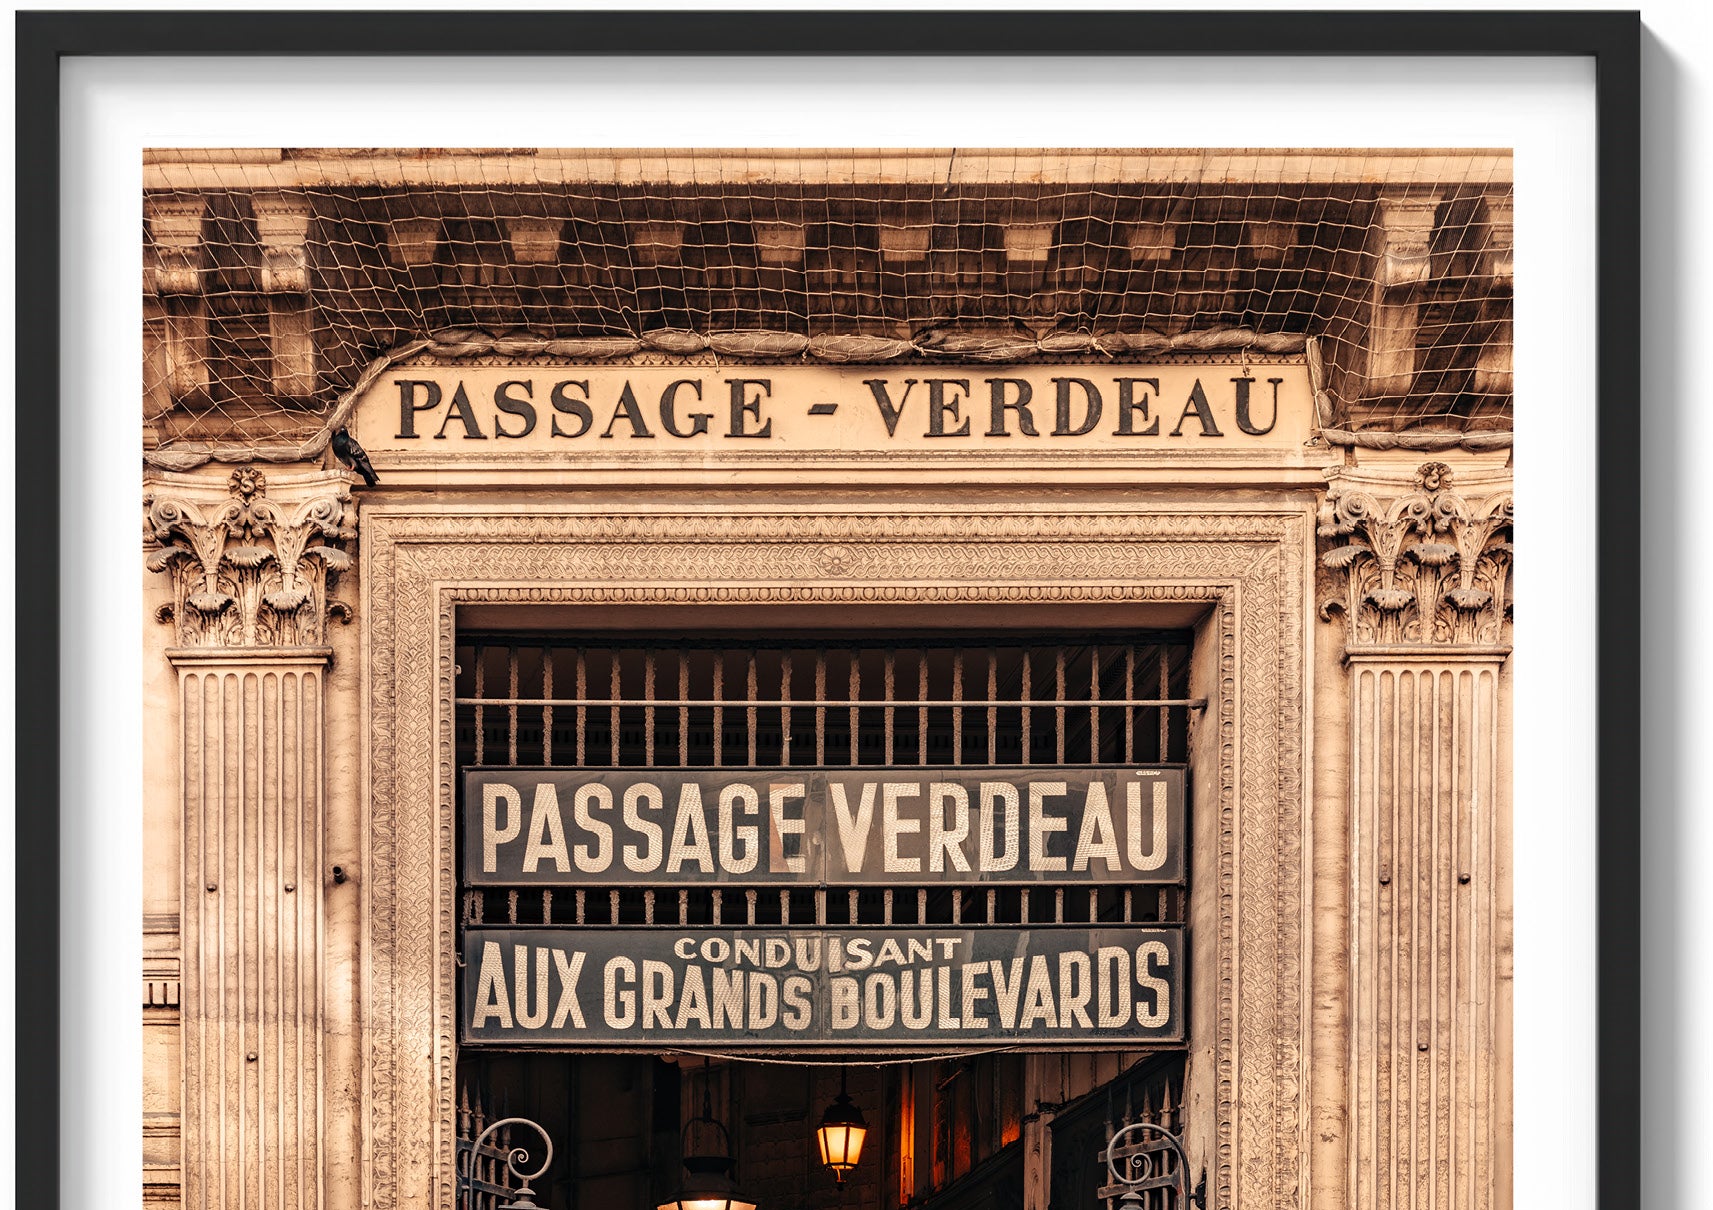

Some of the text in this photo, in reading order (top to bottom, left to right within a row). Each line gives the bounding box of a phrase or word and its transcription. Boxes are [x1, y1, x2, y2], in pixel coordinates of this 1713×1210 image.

[394, 378, 773, 439] PASSAGE
[863, 377, 1282, 438] VERDEAU
[483, 781, 1169, 874] PASSAGE VERDEAU
[471, 940, 1170, 1031] AUX GRANDS BOULEVARDS
[674, 937, 963, 974] CONDUISANT
